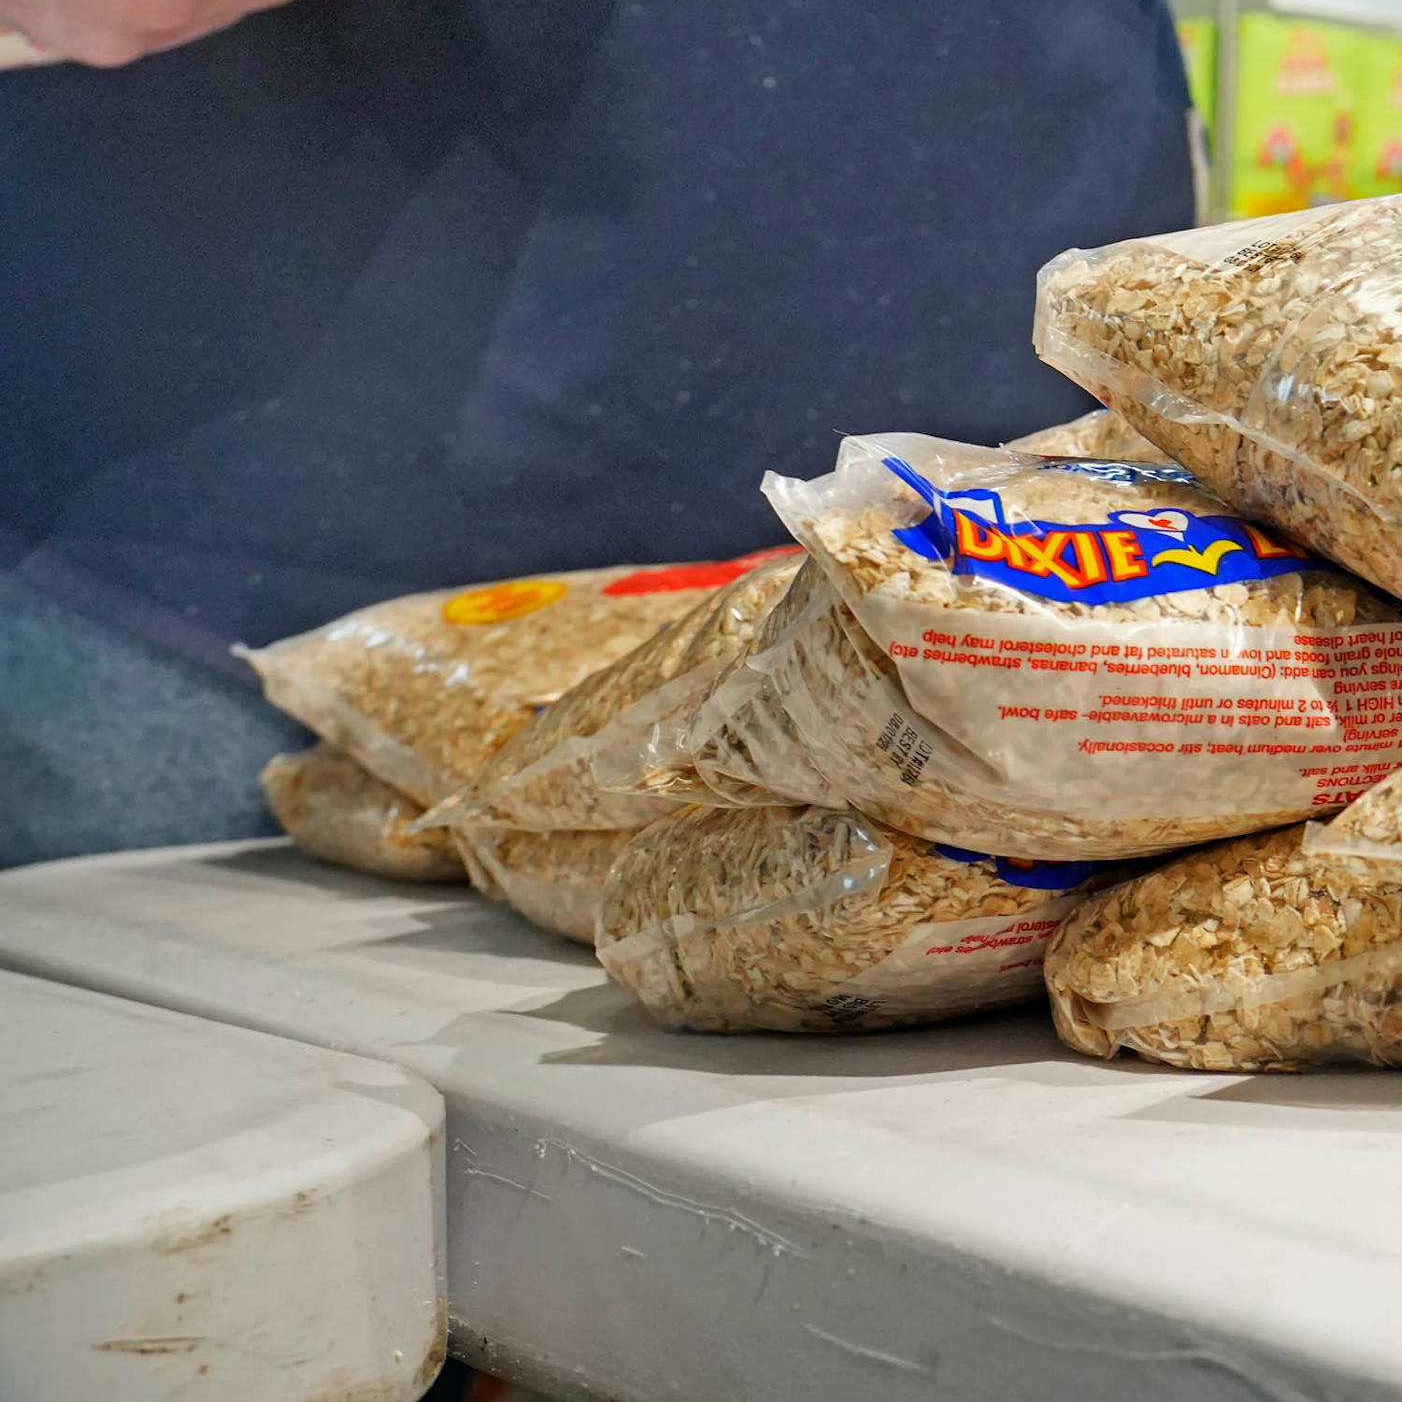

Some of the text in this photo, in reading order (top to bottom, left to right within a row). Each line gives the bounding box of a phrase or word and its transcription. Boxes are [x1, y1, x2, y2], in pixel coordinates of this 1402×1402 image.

[952, 508, 1150, 590] DIXIE
[922, 630, 957, 646] help
[961, 634, 995, 650] may
[1347, 632, 1384, 646] heart
[888, 641, 918, 658] etc)
[999, 640, 1087, 657] cholesterol
[1092, 645, 1120, 659] and
[1124, 644, 1143, 659] fat
[1146, 646, 1217, 661] saturated
[1334, 645, 1370, 662] grain
[923, 648, 1022, 671] strawberries
[1265, 650, 1292, 662] and
[1294, 650, 1331, 663] foods
[1027, 657, 1097, 675] bananas,
[1103, 660, 1191, 677] blueberries,
[1196, 661, 1277, 679] (Cinnamon,
[1280, 666, 1309, 678] add:
[1312, 667, 1336, 678] can
[1340, 663, 1368, 678] you
[1332, 679, 1387, 695] serving
[1098, 694, 1177, 710] thickened.
[1181, 698, 1214, 711] until
[1217, 698, 1233, 709] or
[1237, 699, 1294, 712] minutes
[1297, 699, 1306, 712] 2
[1310, 699, 1323, 711] to
[1345, 699, 1352, 711] 1
[1357, 697, 1395, 709] HIGH
[997, 706, 1040, 721] bowl.
[1045, 709, 1078, 721] safe
[1207, 714, 1216, 724] a
[1220, 714, 1234, 727] in
[1372, 713, 1385, 724] or
[1238, 715, 1270, 727] oats
[1275, 716, 1301, 727] and
[1304, 716, 1331, 727] salt
[896, 725, 918, 757] BEST
[1343, 728, 1399, 742] serving)
[1077, 739, 1174, 753] occasionally.
[1177, 741, 1203, 754] stir
[1206, 743, 1244, 756] heat;
[1248, 743, 1306, 756] medium
[1311, 743, 1341, 754] over
[1345, 740, 1393, 754] minute
[1299, 762, 1391, 778] milk and salt.
[1312, 790, 1363, 806] ATS
